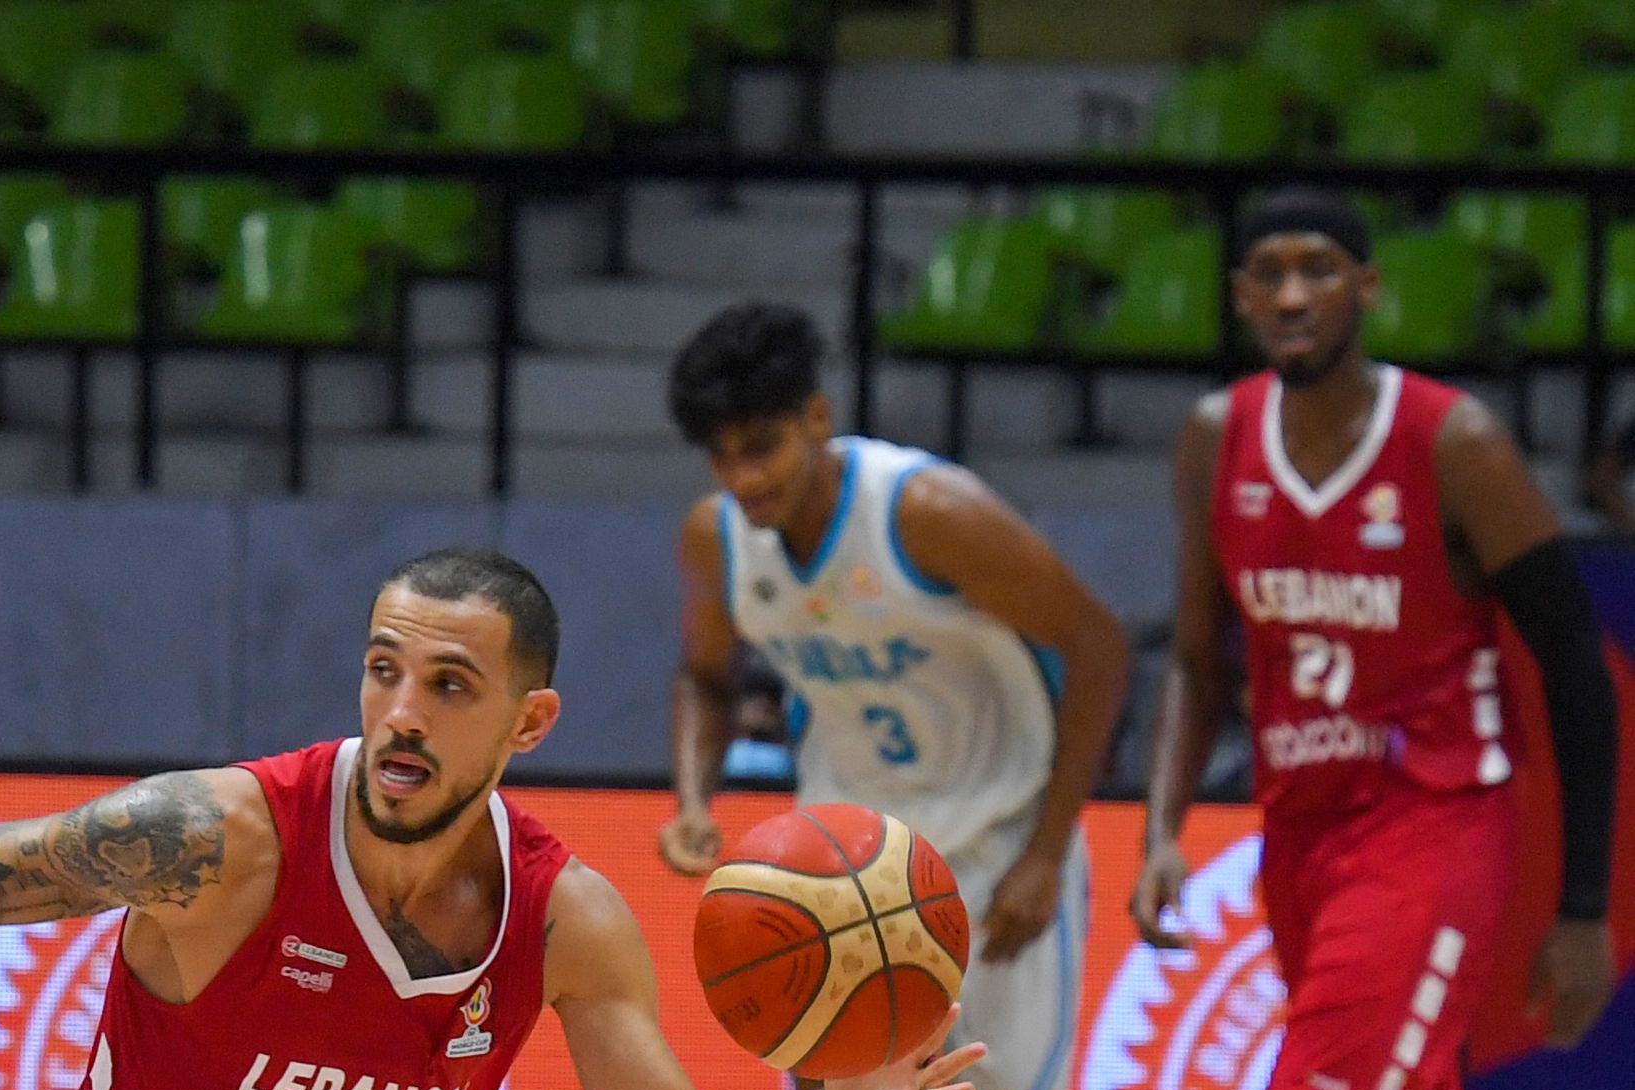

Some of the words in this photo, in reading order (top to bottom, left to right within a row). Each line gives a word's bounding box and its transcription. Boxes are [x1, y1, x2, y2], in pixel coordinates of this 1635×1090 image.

[1238, 567, 1403, 633] LEBANON
[861, 704, 919, 767] 3
[280, 965, 334, 986] capelli
